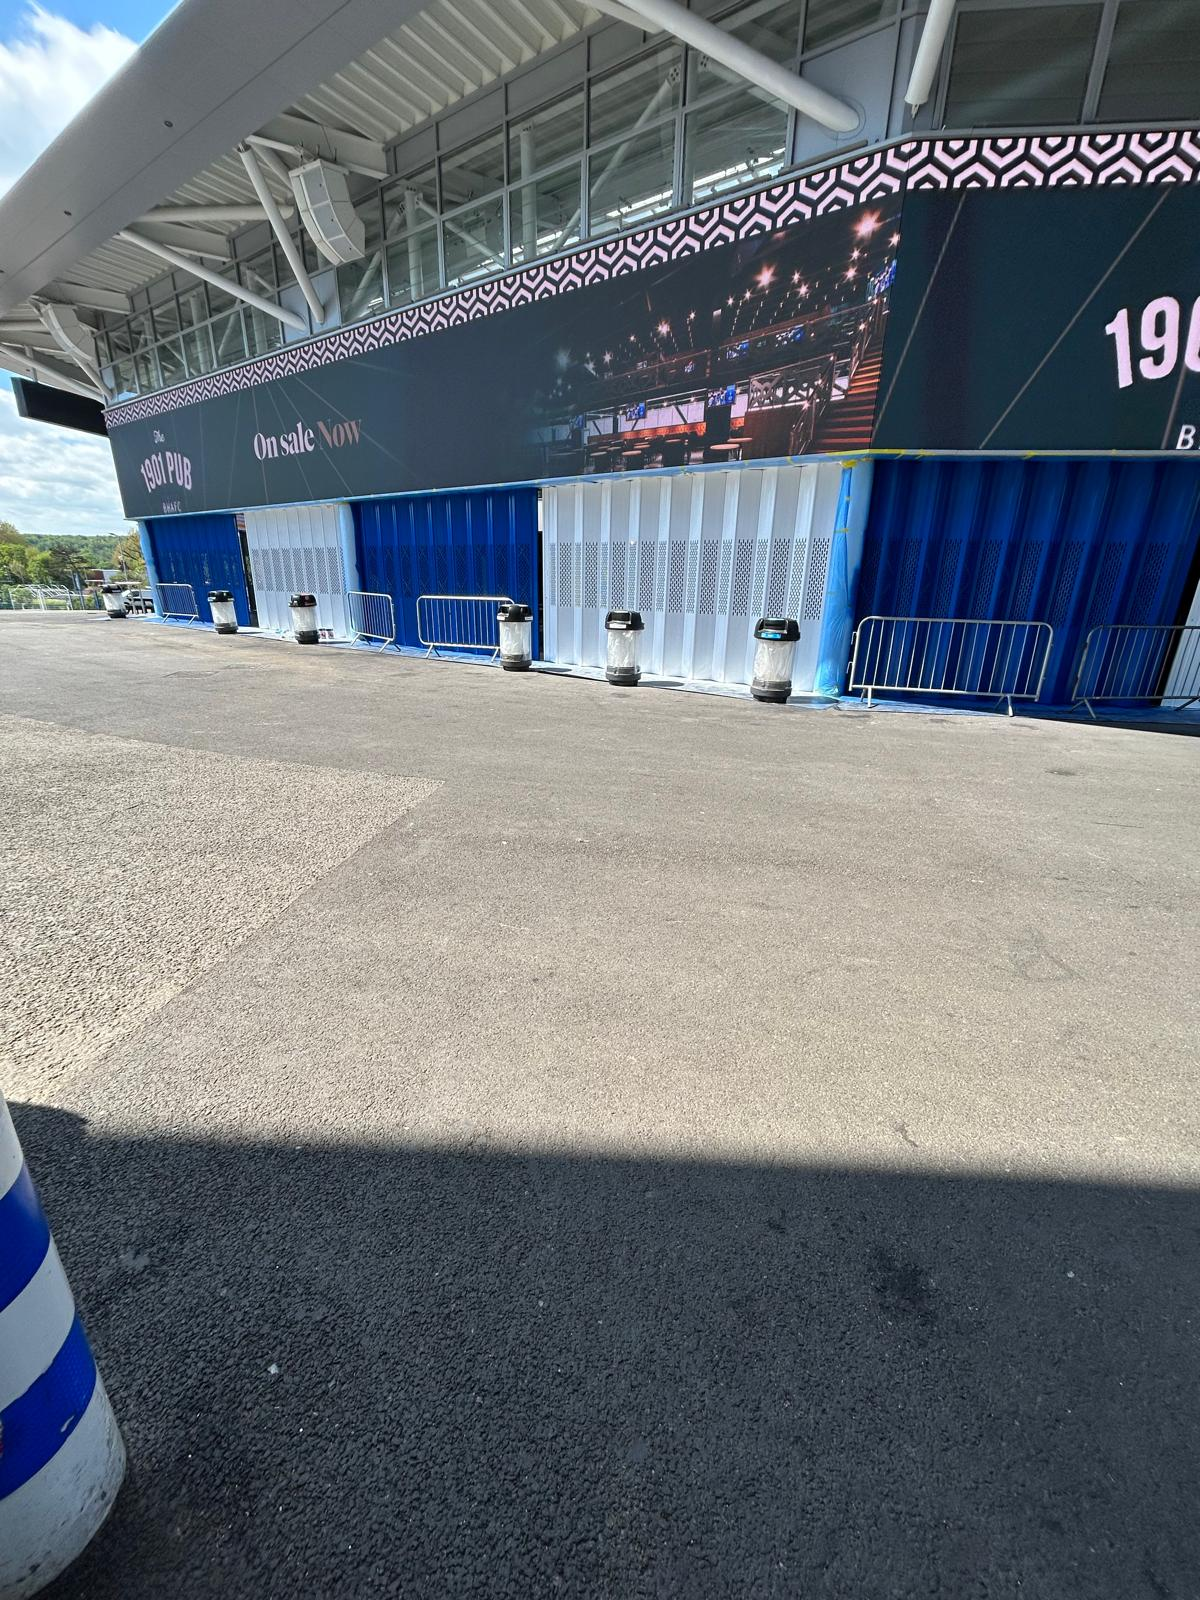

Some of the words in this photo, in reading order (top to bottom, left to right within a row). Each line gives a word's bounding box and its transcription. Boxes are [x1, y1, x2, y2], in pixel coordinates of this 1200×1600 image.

[253, 432, 279, 461] On
[280, 422, 315, 457] sale
[316, 418, 362, 450] Now
[140, 451, 167, 493] 1901
[165, 451, 192, 491] PUB
